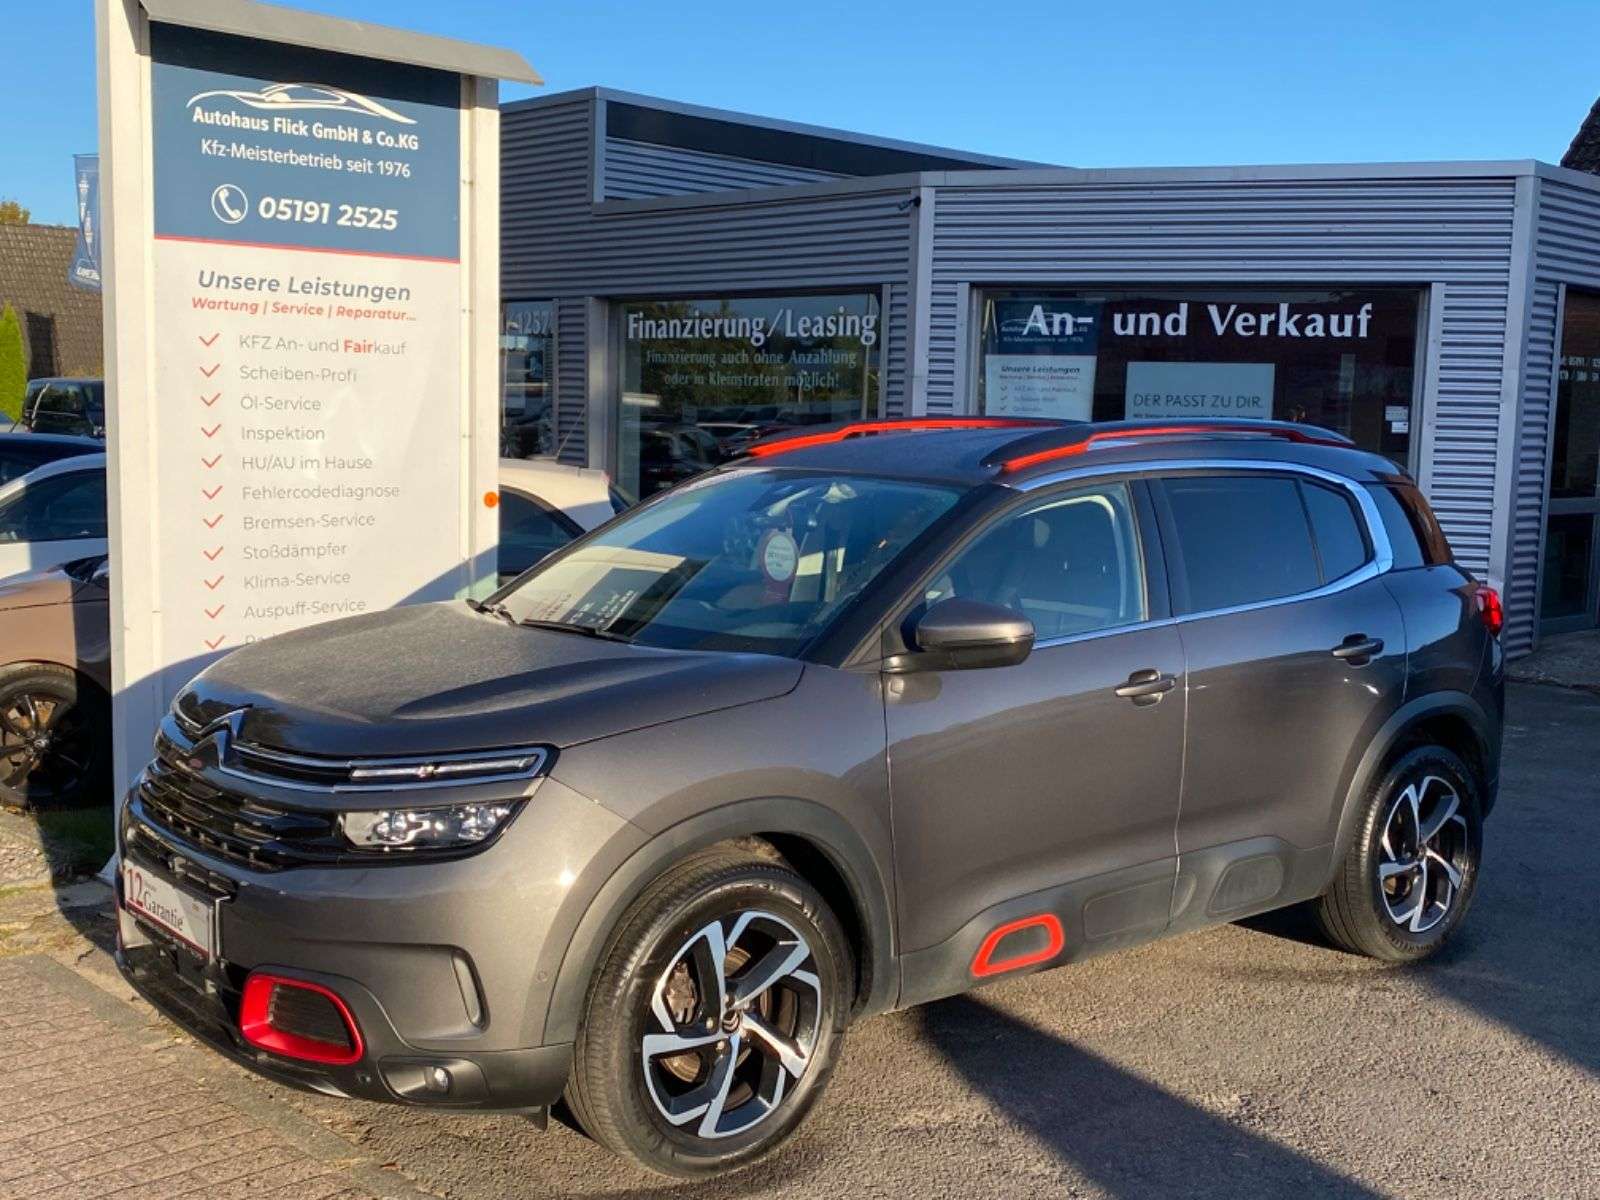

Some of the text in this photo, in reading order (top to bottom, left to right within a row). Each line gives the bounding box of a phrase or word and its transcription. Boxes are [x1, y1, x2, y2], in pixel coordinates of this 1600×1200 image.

[192, 106, 419, 151] Autohaus Flick GmbH & Co.KG
[200, 138, 411, 178] Kfz-Meisterbetrieb seit 1976
[258, 196, 399, 231] 05191 2525
[198, 270, 411, 302] Unsere Leistungen
[191, 296, 259, 315] Wartung
[271, 302, 324, 317] Service
[627, 306, 878, 347] Finanzierung/Leasing
[1022, 303, 1372, 337] An- und Verkauf
[239, 334, 406, 355] KFZ An- und Fairkauf
[646, 347, 857, 369] Finanzierung auch ohne Anzahlung
[239, 364, 357, 383] Scheiben-Profi
[708, 370, 779, 387] Kleinstraten
[783, 370, 840, 392] möglich!
[1133, 393, 1162, 407] DER
[1165, 394, 1207, 408] PASST
[1211, 394, 1232, 408] ZU
[241, 426, 325, 443] Inspektion
[242, 455, 373, 470] HU/AU im Hause
[242, 483, 400, 501] Fehlercodediagnose
[243, 513, 375, 530] Bremsen-Service
[243, 543, 347, 561] Stoßdämpfer
[244, 573, 351, 590] Klima-Service
[244, 599, 367, 620] Auspuff-Service
